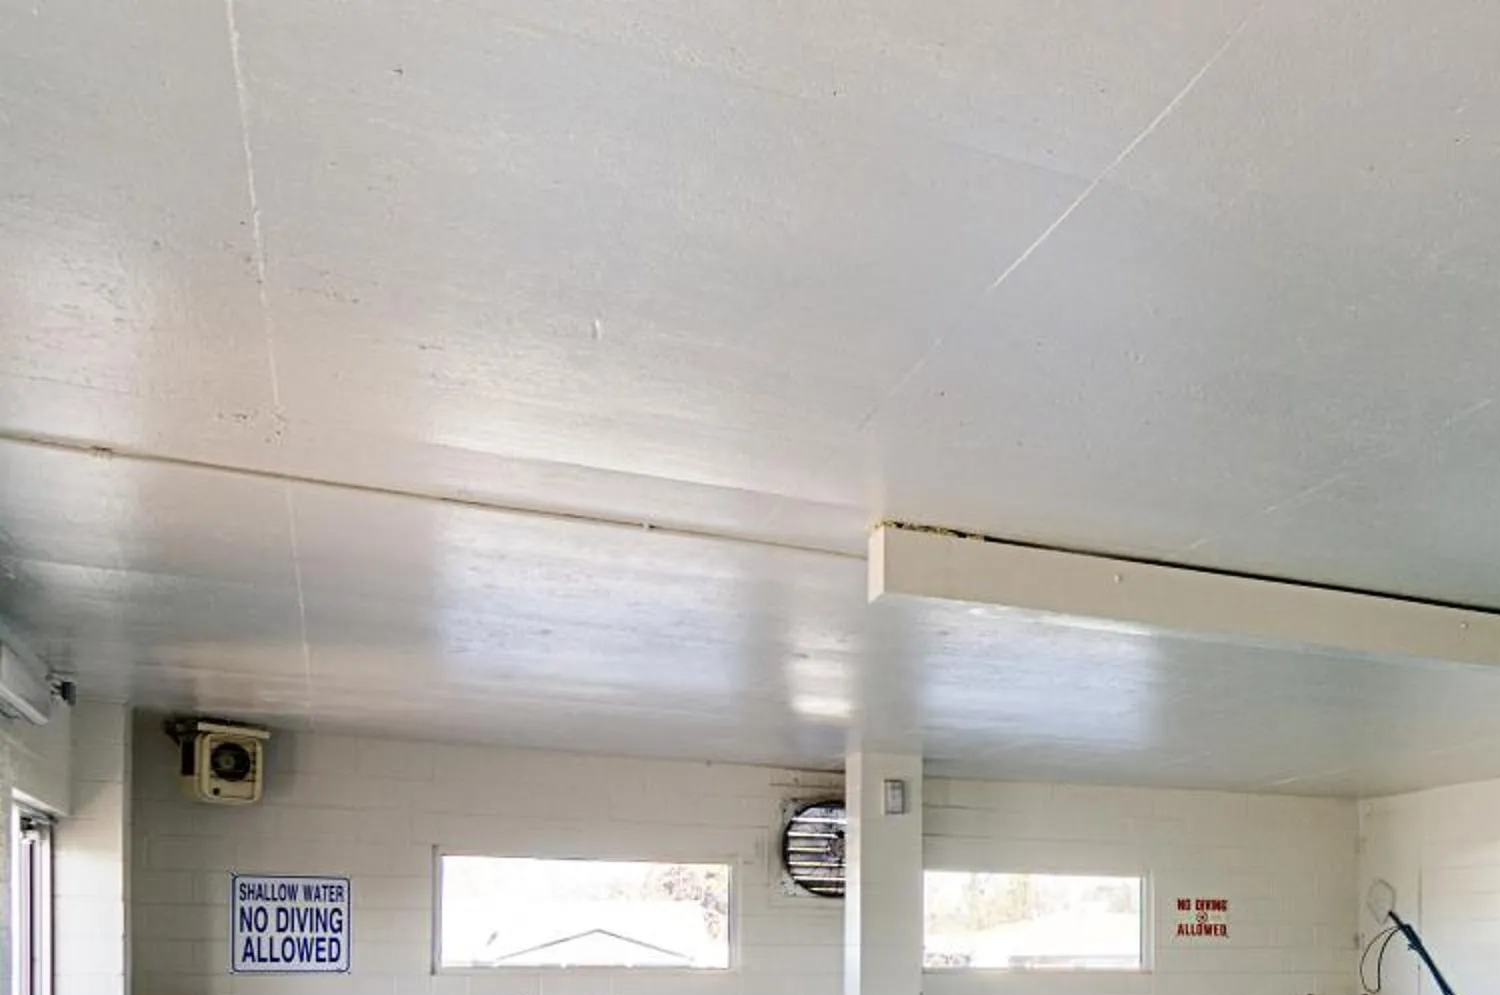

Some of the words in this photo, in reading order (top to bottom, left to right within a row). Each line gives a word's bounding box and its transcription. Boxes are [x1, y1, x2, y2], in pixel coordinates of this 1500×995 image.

[239, 883, 299, 901] SHALLOW
[303, 885, 344, 902] WATER
[1177, 898, 1191, 910] NO
[1195, 899, 1228, 911] DIVING
[239, 906, 269, 933] NO
[276, 907, 343, 933] DIVING
[1177, 923, 1227, 936] ALLOWED
[242, 936, 341, 963] ALLOWED
